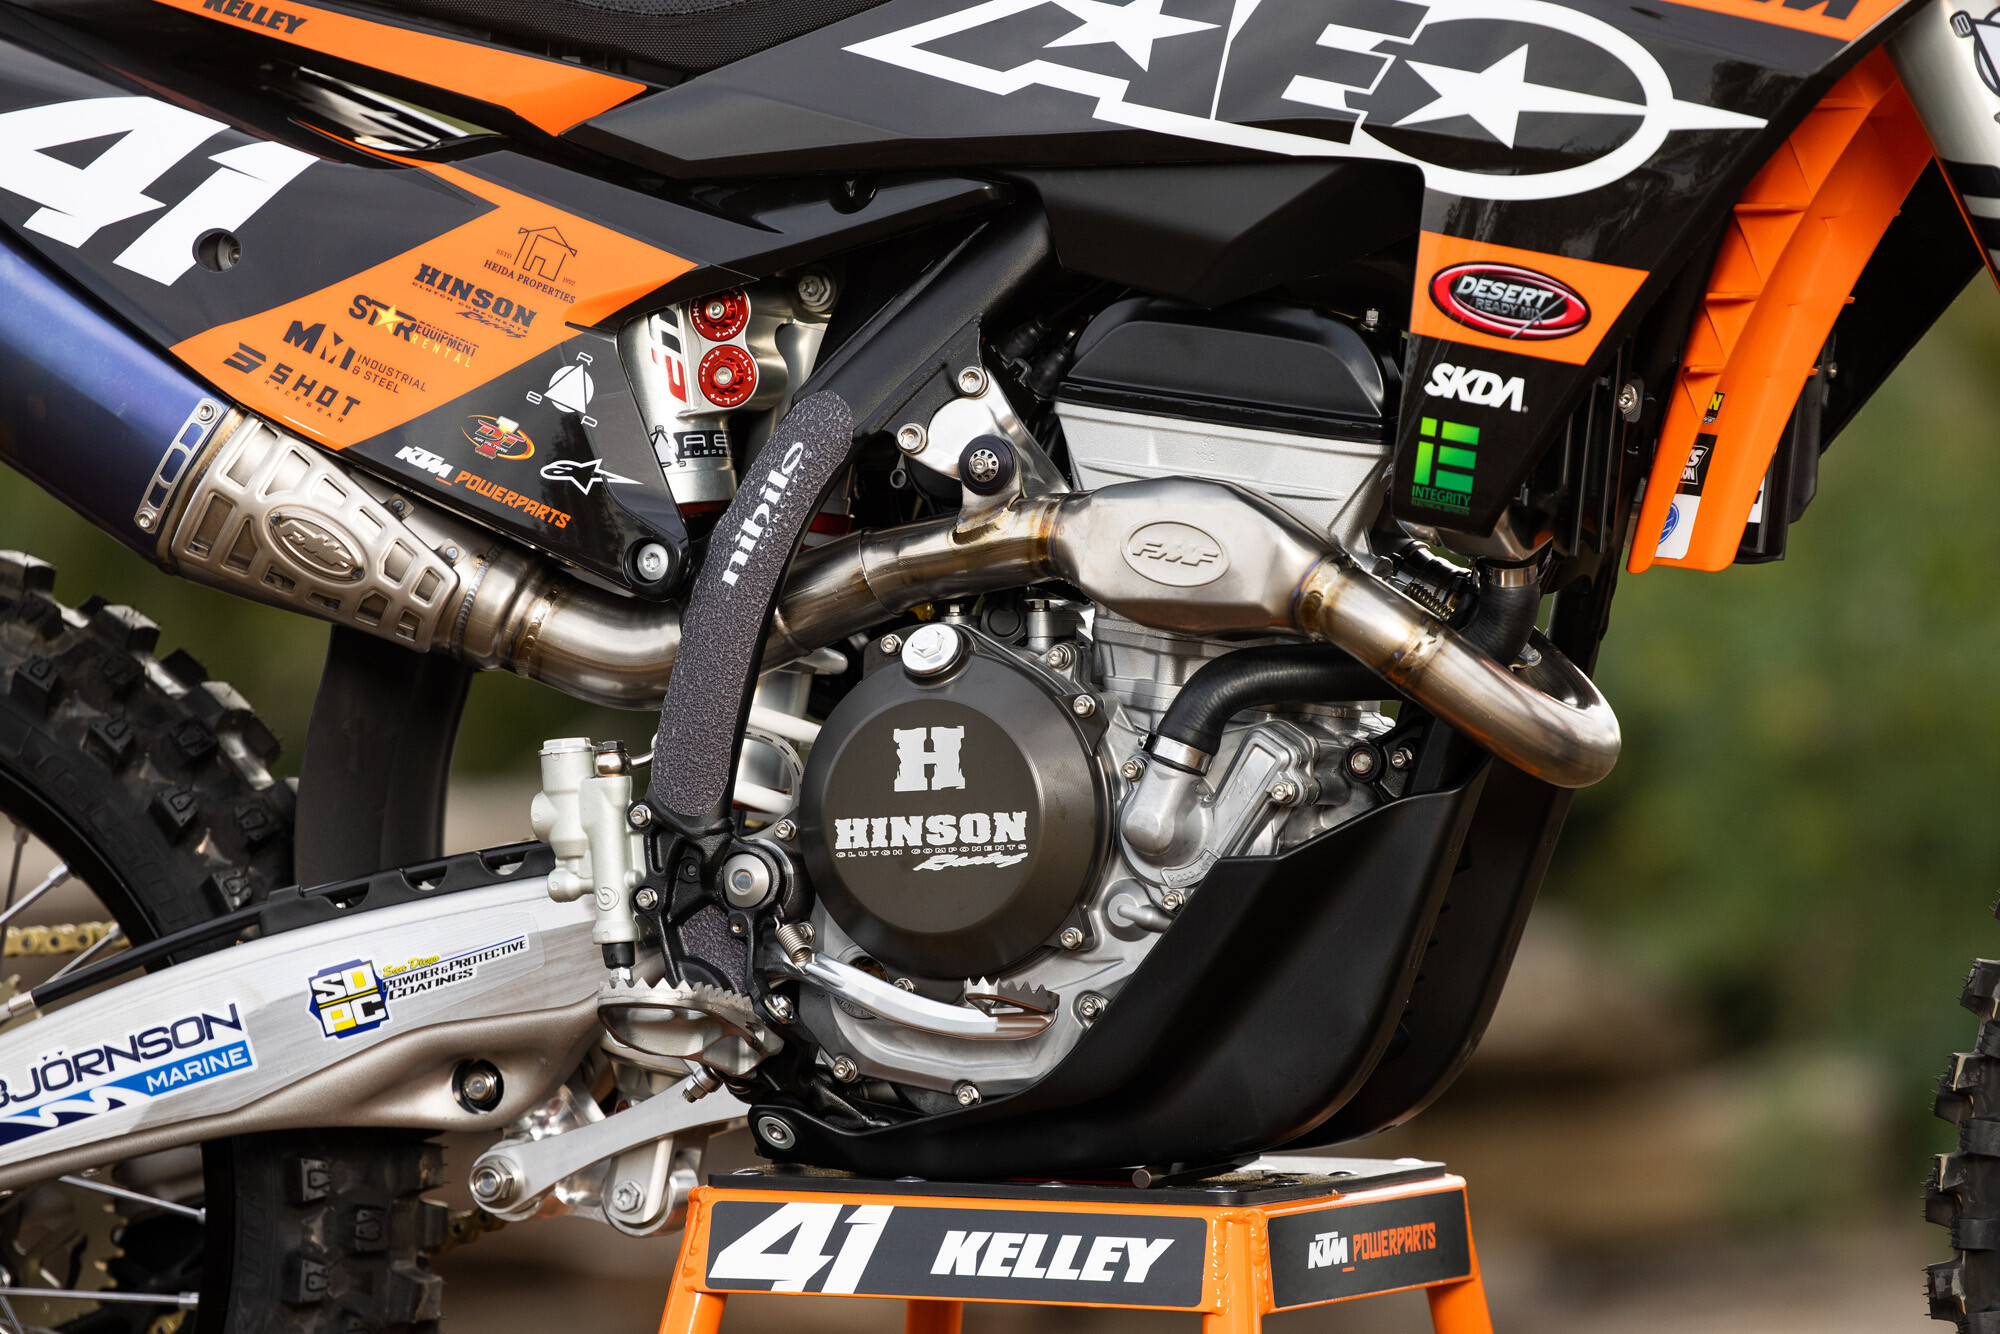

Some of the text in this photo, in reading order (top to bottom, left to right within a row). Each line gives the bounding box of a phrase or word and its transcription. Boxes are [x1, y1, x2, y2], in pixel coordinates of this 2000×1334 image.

[0, 96, 320, 286] 41
[496, 248, 512, 259] ESTD
[414, 262, 537, 328] HINSON
[483, 259, 576, 304] HEJDA PROPERTIES
[562, 277, 576, 286] 1992
[1455, 275, 1553, 309] DESERT
[412, 281, 528, 334] CLUTCH COMPONENTS
[1474, 297, 1518, 317] READY
[410, 333, 471, 368] RENTAL
[415, 320, 480, 357] EQUIPMENT
[268, 362, 361, 417] SHOT
[352, 365, 399, 394] & STEEL
[357, 354, 426, 392] INDUSTRIAL
[1424, 362, 1525, 412] SKDA
[264, 379, 343, 423] RACEGEAR
[395, 446, 571, 529] KTM POWERPARTS
[1411, 484, 1471, 507] INTEGRITY
[721, 441, 804, 587] nihilo
[1131, 539, 1218, 567] FMF
[893, 725, 966, 792] H
[834, 811, 1028, 850] HINSON
[835, 843, 1027, 858] CLUTCH COMPONENTS
[382, 966, 439, 992] POWDER
[450, 939, 527, 972] PROTECTIVE
[383, 954, 440, 978] San Diego
[388, 967, 474, 1001] COATINGS
[146, 1046, 248, 1092] MARINE
[708, 1202, 1176, 1294] 41 KELLEY
[1307, 1222, 1437, 1269] KTM POWERPARTS
